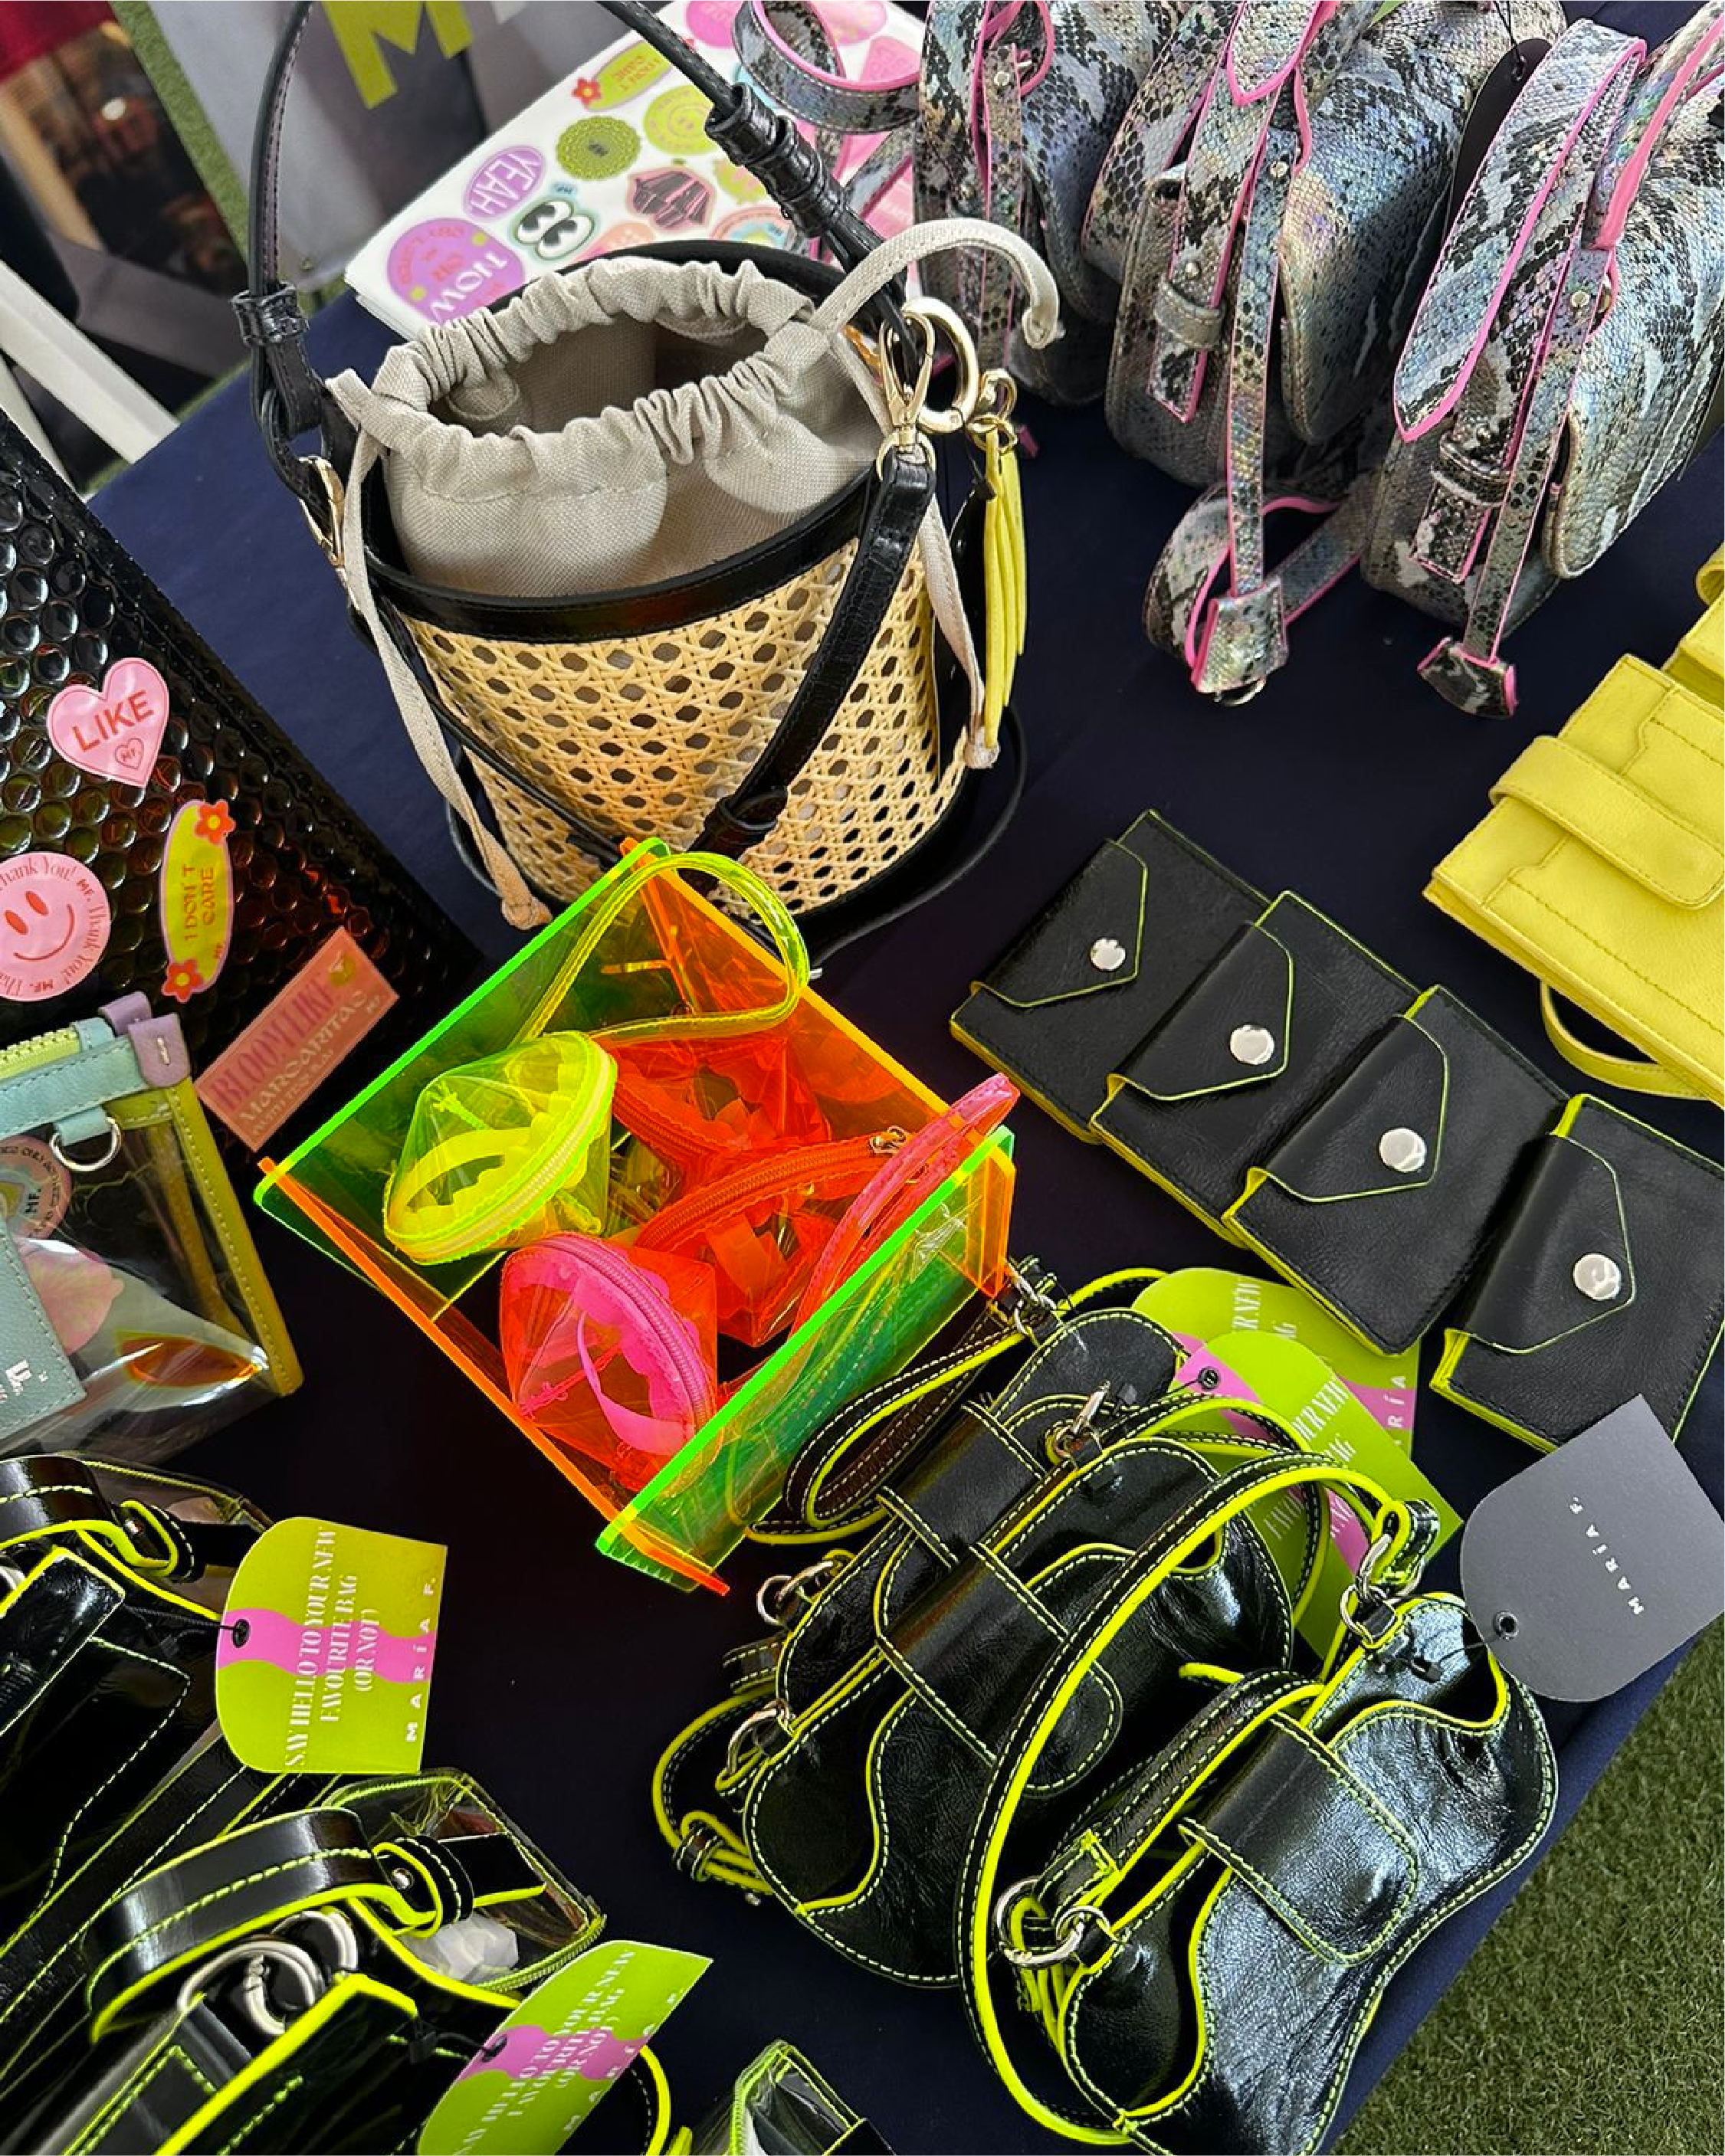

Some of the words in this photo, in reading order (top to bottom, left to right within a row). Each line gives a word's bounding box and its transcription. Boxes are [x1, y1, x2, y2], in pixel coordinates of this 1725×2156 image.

[470, 153, 541, 215] YEAH
[431, 252, 509, 323] NOW
[71, 690, 154, 752] LIKE
[201, 867, 216, 926] CARE
[208, 1017, 297, 1113] BLOOM
[312, 1526, 336, 1571] NEW
[1586, 1524, 1645, 1614] MARÍA
[303, 1574, 330, 1626] YOUR
[335, 1574, 357, 1616] BAG
[298, 1630, 322, 1656] TO
[320, 1612, 353, 1722] FAVOURITE
[289, 1660, 317, 1725] HELLO
[405, 1618, 431, 1742] MARÍA
[284, 1729, 309, 1766] SAY
